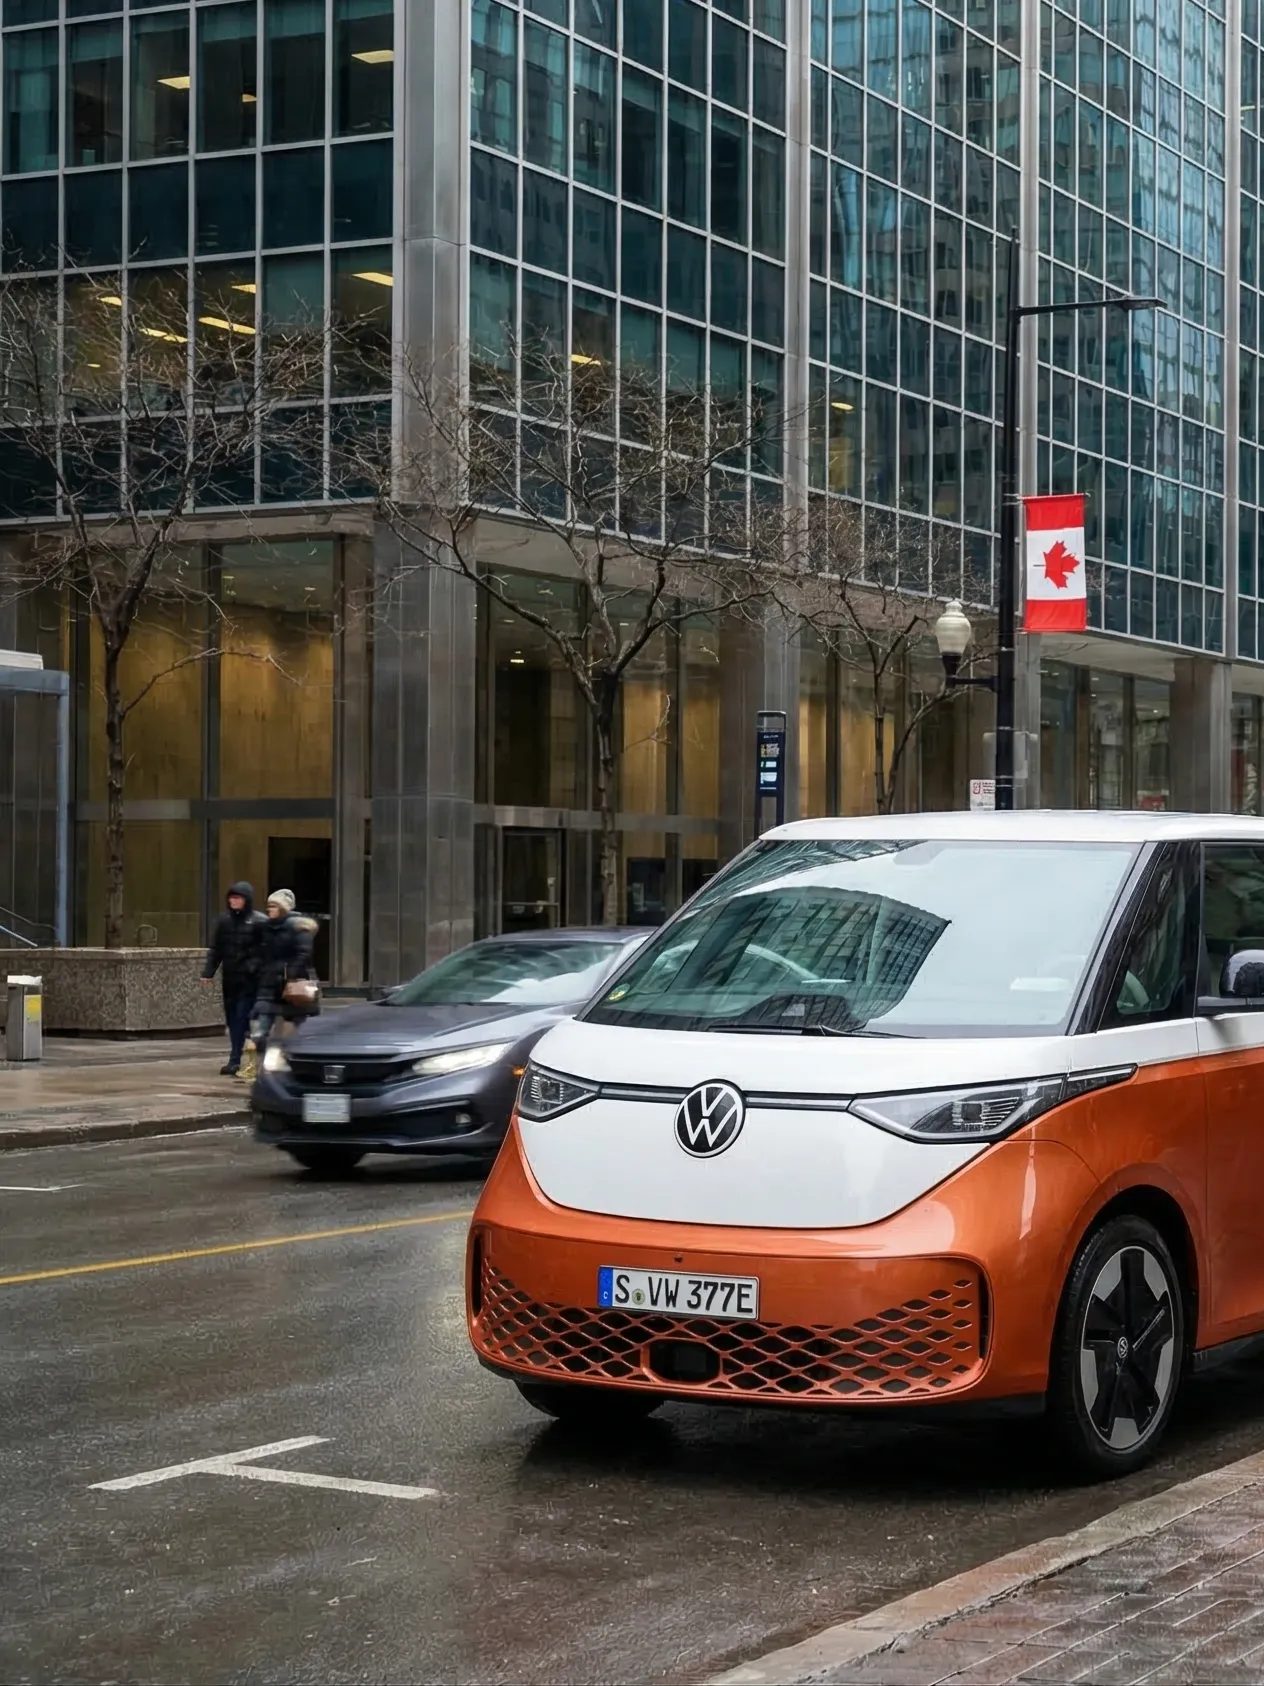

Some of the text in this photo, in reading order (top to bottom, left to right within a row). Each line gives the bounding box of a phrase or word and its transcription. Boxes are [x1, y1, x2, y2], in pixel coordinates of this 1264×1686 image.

[680, 1084, 741, 1150] VW
[615, 1274, 753, 1314] S VW 377E
